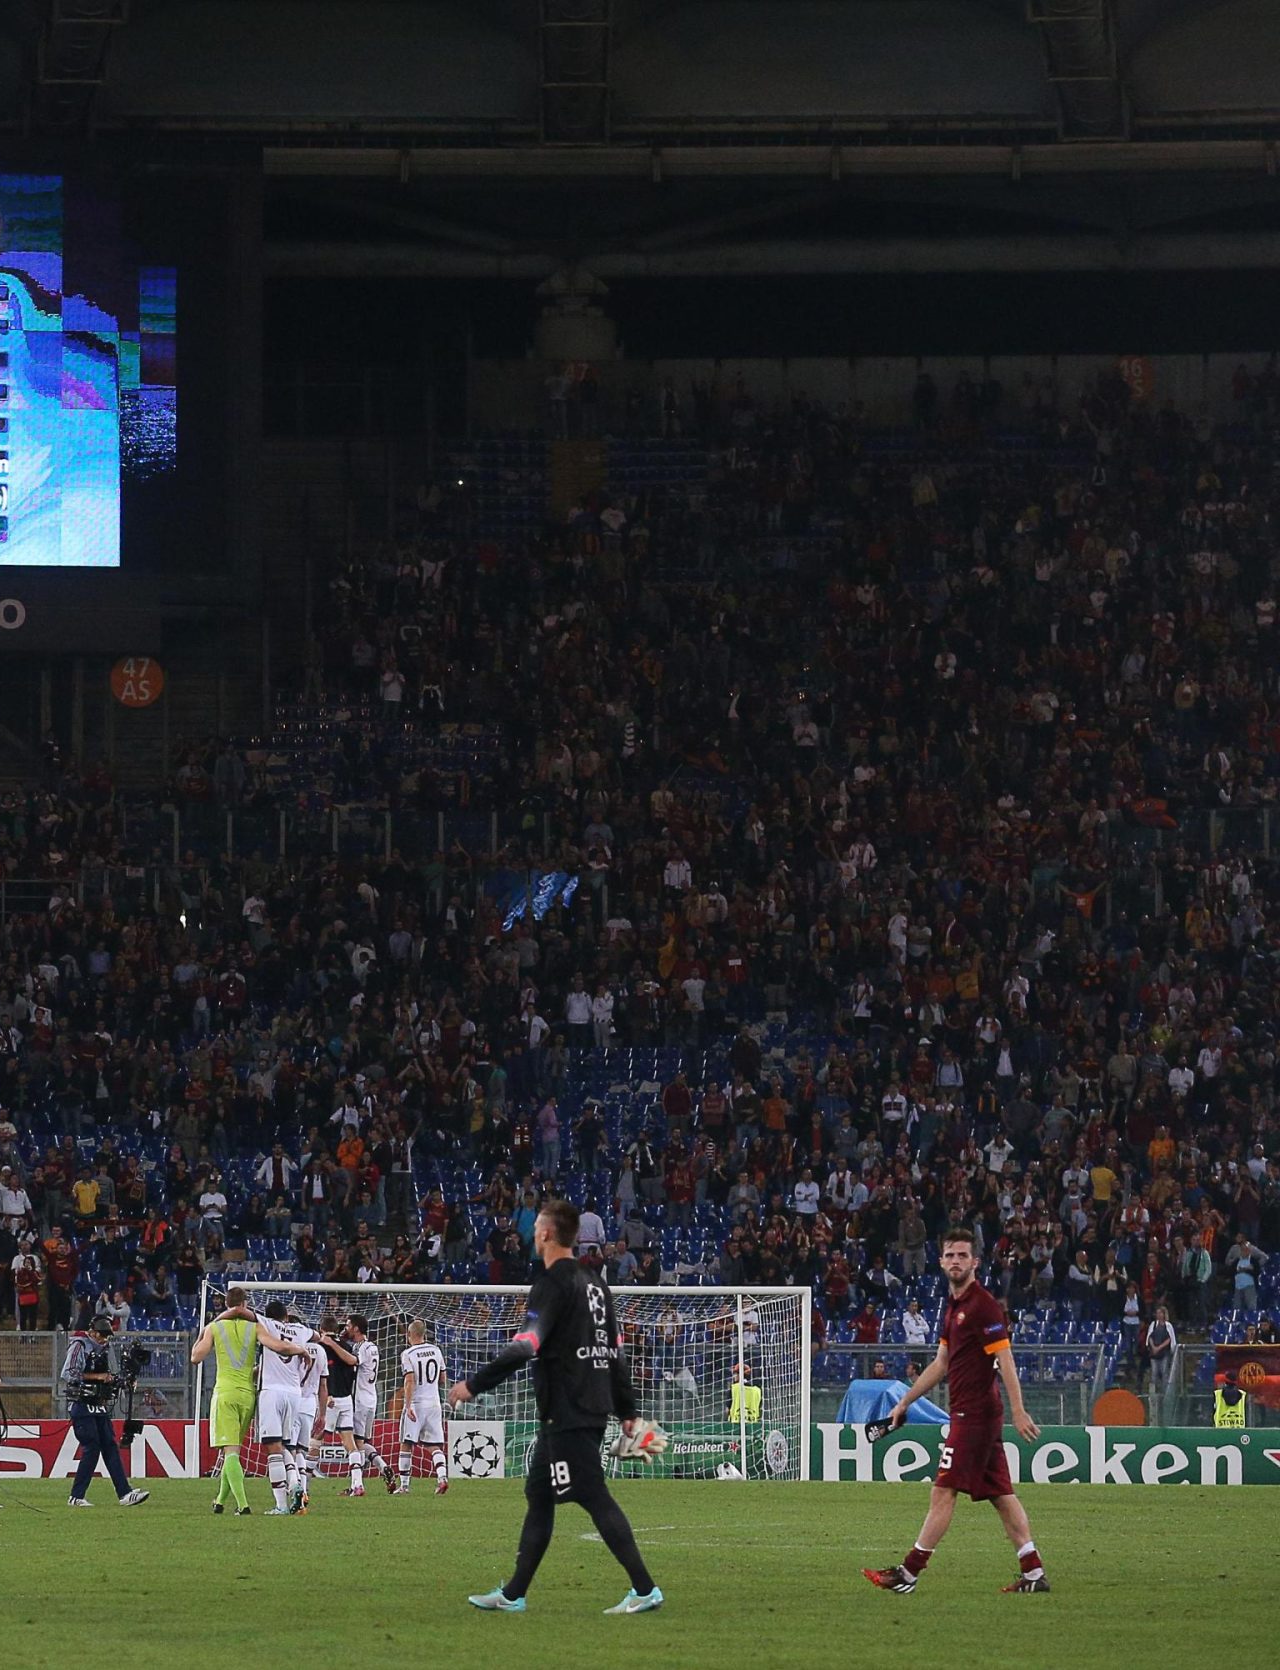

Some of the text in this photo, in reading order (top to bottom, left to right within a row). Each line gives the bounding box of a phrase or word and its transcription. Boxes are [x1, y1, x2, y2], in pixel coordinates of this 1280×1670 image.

[122, 657, 150, 678] 47
[121, 680, 150, 701] AS
[417, 1358, 438, 1386] 10
[673, 1442, 724, 1454] Heineken
